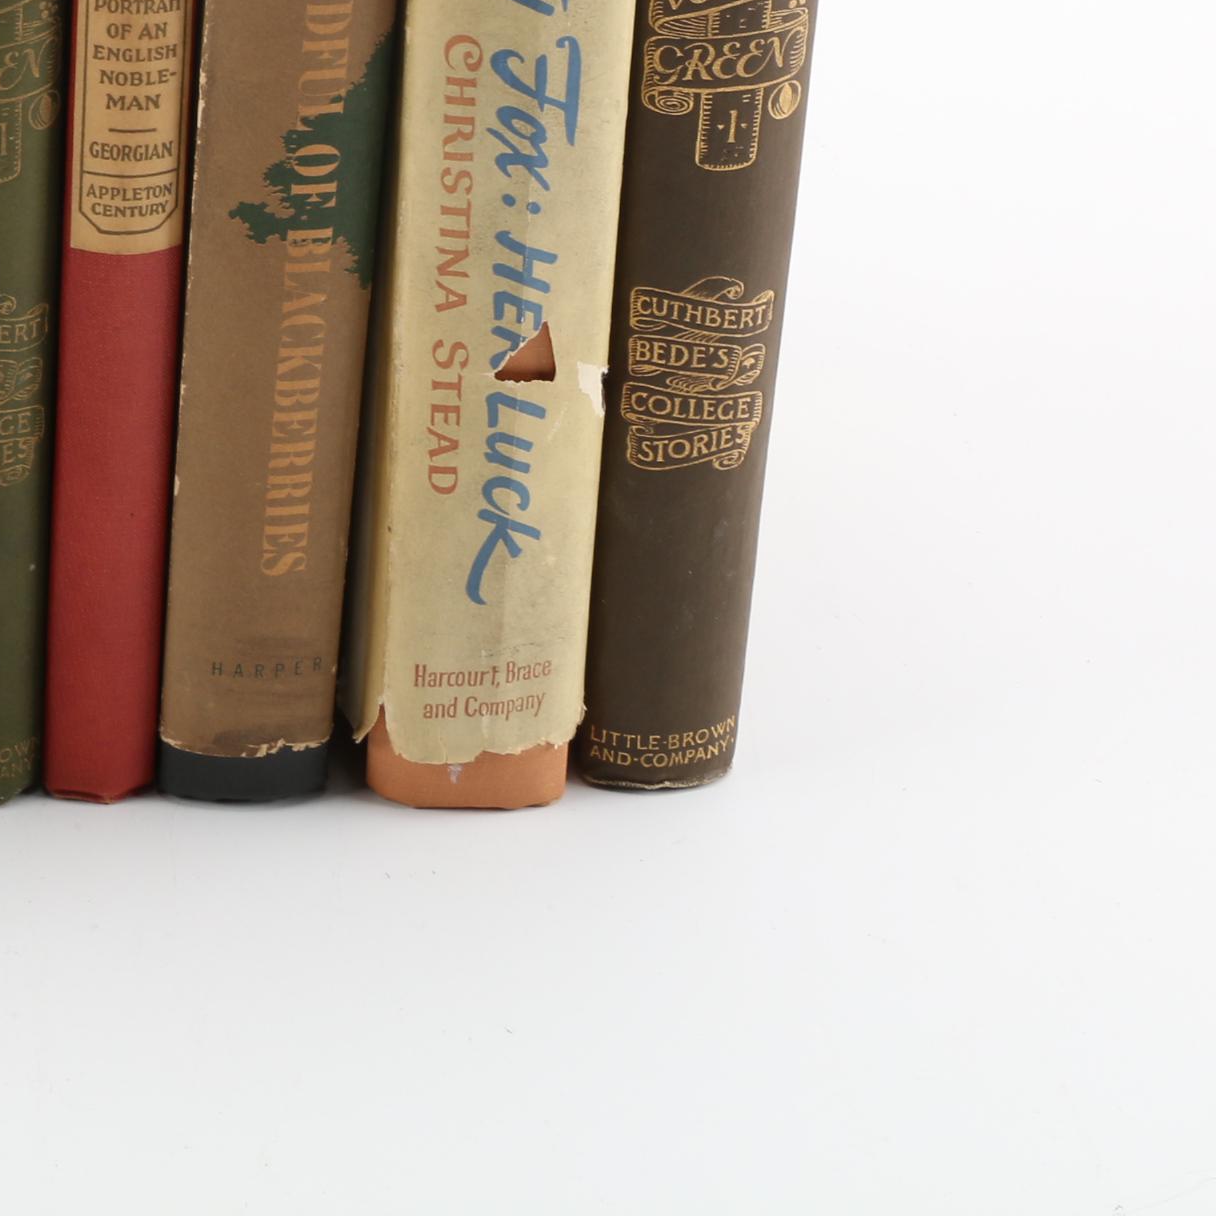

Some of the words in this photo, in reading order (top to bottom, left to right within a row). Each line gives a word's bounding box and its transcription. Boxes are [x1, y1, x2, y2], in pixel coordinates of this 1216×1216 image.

[106, 23, 132, 40] OF
[138, 21, 168, 40] AN
[92, 43, 177, 62] ENGLISH
[653, 27, 805, 84] GREEN
[99, 68, 177, 86] NOBLE-
[105, 93, 161, 111] MAN
[486, 36, 581, 214] Fox:
[89, 140, 173, 162] GEORGIAN
[291, 144, 341, 208] OF
[435, 34, 483, 313] CHRISTINA
[86, 182, 173, 201] APPLETON
[91, 200, 168, 217] CENTURY
[638, 296, 766, 329] CUTHBERT
[636, 341, 729, 368] BEDE'S
[260, 226, 333, 577] BLACKBERRIES
[632, 392, 752, 420] COLLEGE
[427, 339, 469, 495] STEAD
[638, 424, 749, 462] STORIES
[212, 656, 322, 678] HARPER
[414, 664, 500, 688] Harcourt,
[505, 660, 552, 684] Brace
[423, 697, 458, 719] and
[464, 692, 546, 721] Company
